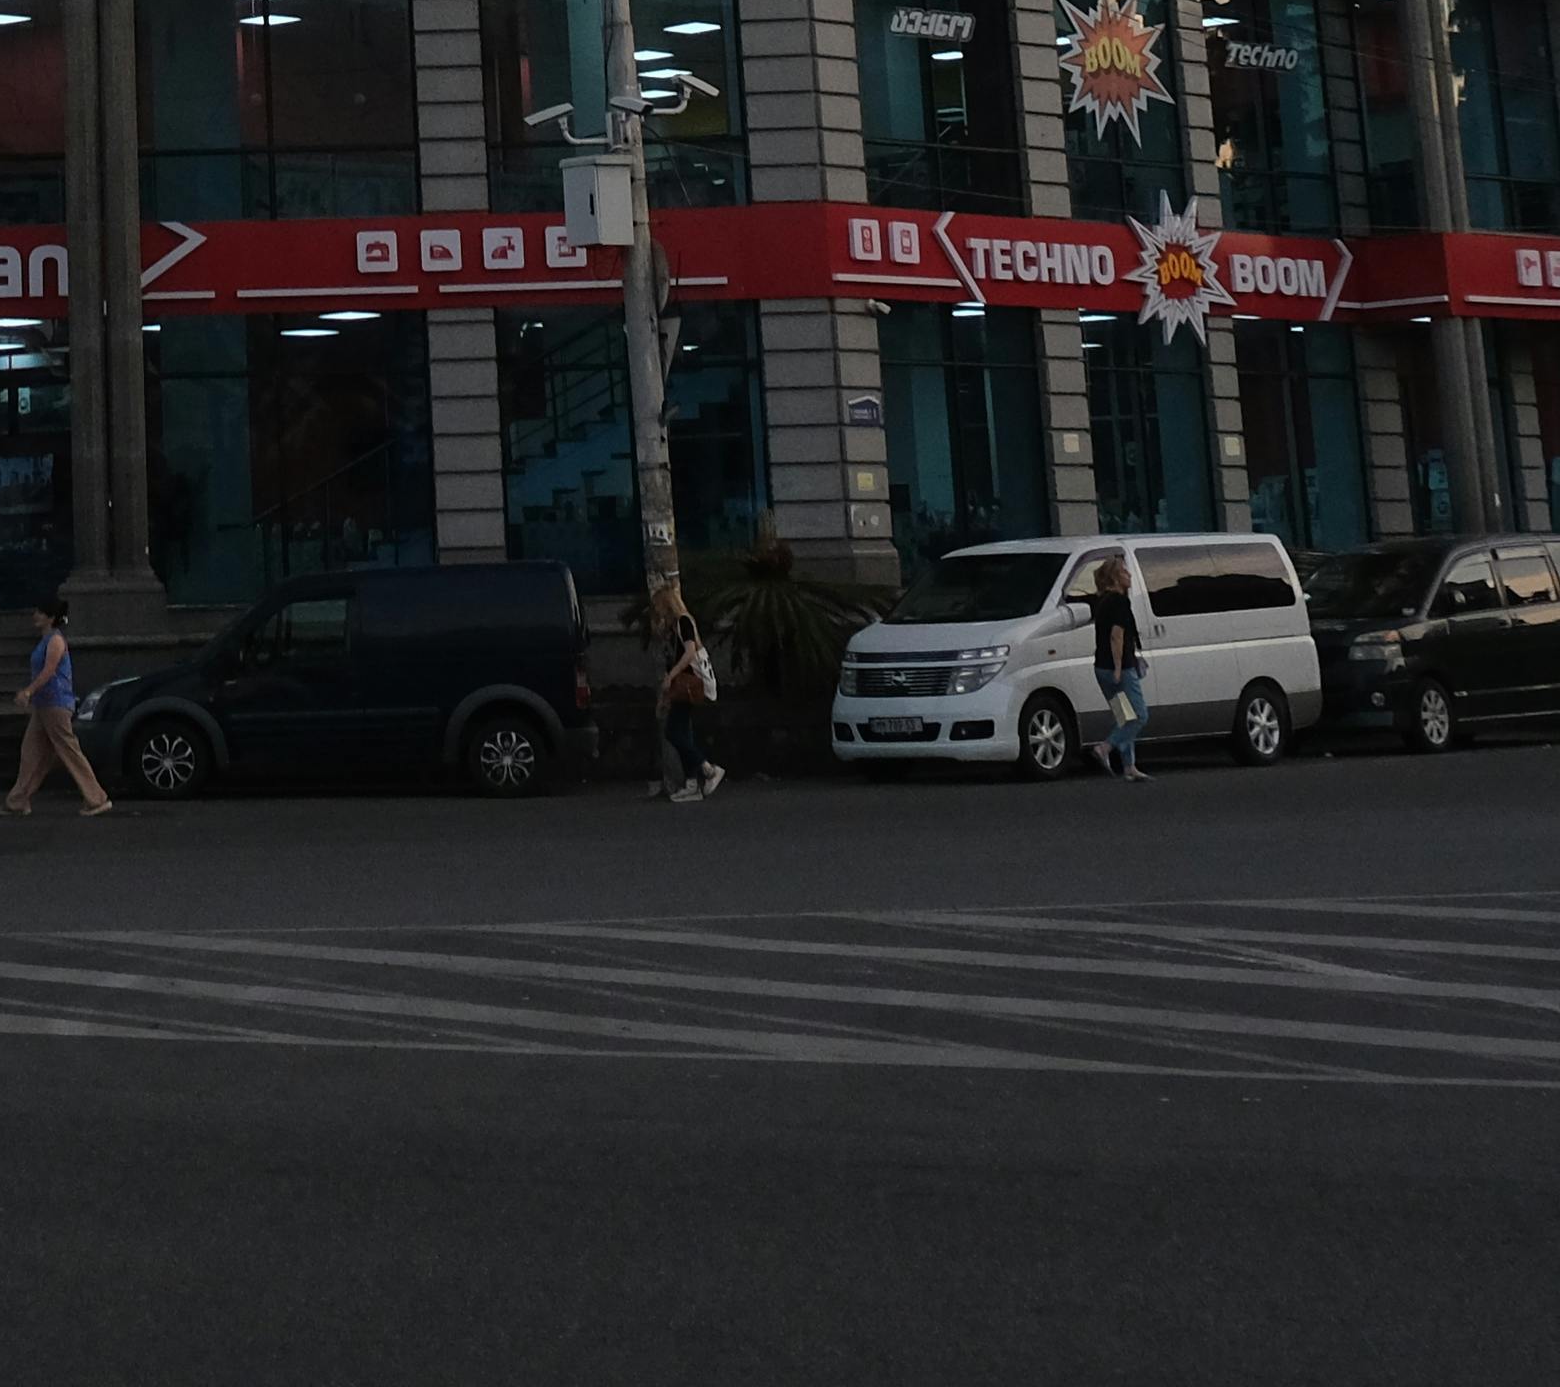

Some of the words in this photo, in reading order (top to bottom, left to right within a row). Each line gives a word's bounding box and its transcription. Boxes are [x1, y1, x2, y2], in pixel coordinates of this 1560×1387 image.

[1084, 36, 1142, 78] BOOM
[966, 237, 1115, 286] TECHNO
[1229, 254, 1327, 297] BOOM
[1158, 251, 1203, 286] BOOM
